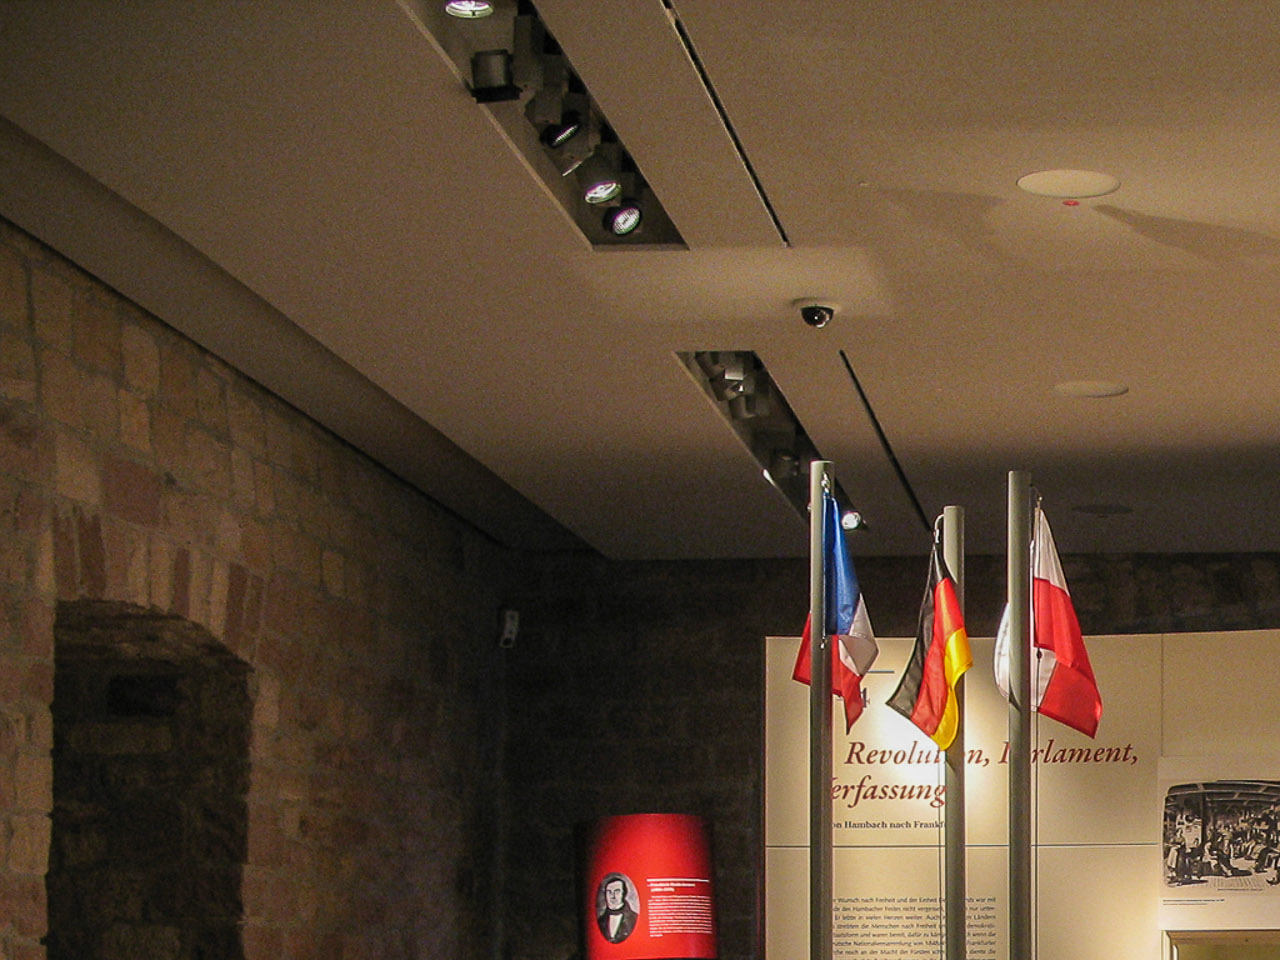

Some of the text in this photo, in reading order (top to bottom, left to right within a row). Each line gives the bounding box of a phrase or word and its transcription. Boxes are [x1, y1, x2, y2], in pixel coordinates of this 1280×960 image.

[844, 739, 1138, 767] Revolutn, Prlament,
[831, 774, 947, 808] erfassung
[844, 820, 888, 829] Hambach
[889, 820, 911, 829] nach
[914, 820, 946, 829] Frankf
